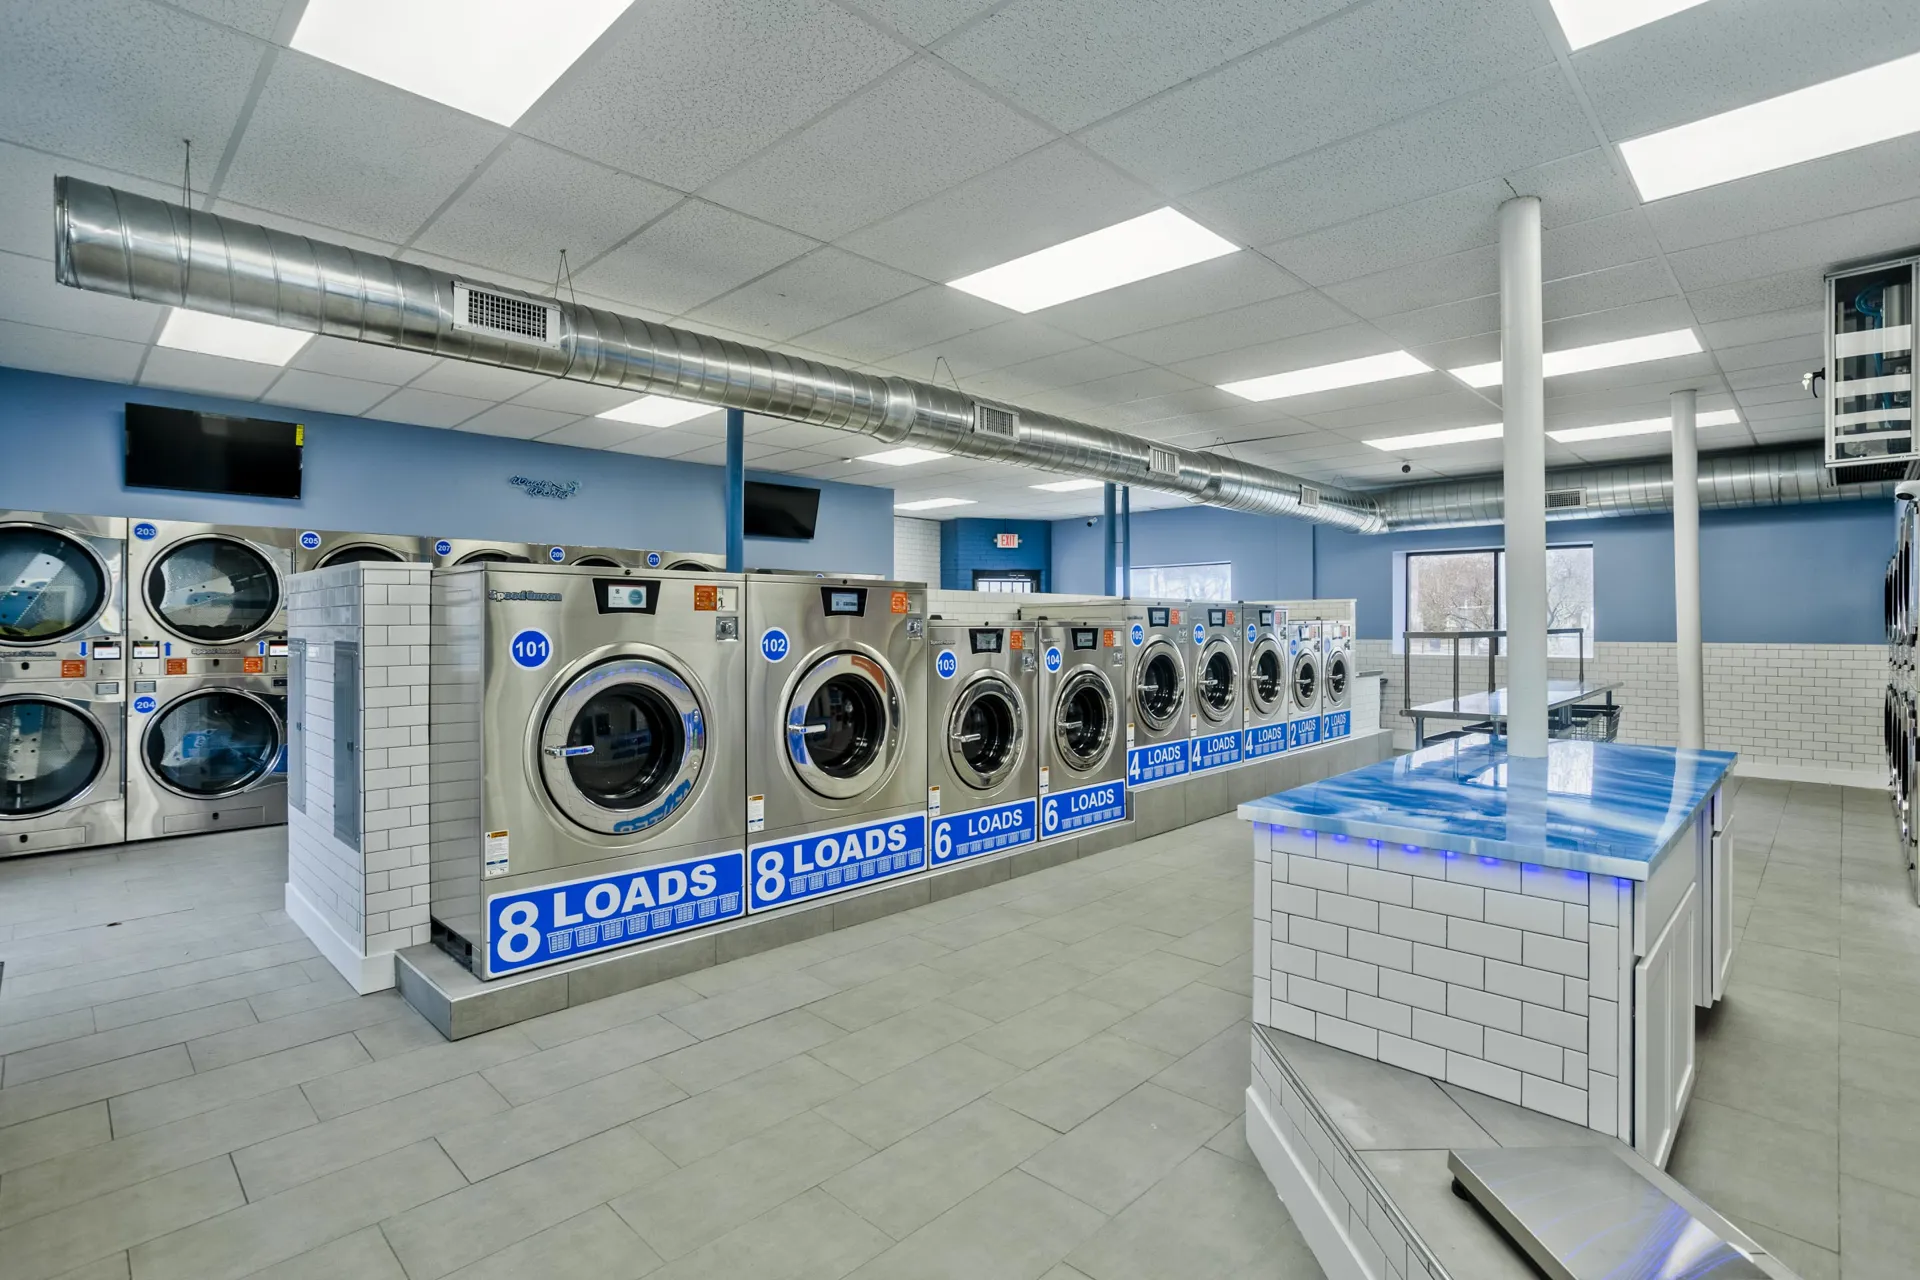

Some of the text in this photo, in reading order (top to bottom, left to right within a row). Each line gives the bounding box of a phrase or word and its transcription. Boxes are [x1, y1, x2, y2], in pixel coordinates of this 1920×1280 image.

[136, 527, 156, 538] 203
[1001, 535, 1015, 546] EXIT
[302, 536, 319, 546] 205
[437, 544, 451, 552] 207
[489, 590, 562, 602] Speed Queen
[1132, 630, 1143, 640] 105
[515, 641, 547, 658] 101
[762, 638, 786, 653] 102
[938, 661, 955, 671] 103
[1046, 655, 1060, 665] 104
[136, 700, 156, 711] 204
[1290, 718, 1316, 745] 2 LOADS
[1324, 713, 1347, 737] 2 LOADS
[1245, 726, 1282, 755] 4 LOADS
[1192, 735, 1236, 767] 4 LOADS
[1128, 745, 1181, 781] 4 LOADS
[1044, 788, 1115, 832] 6 LOADS
[934, 808, 1023, 859] 6 LOADS
[755, 824, 907, 902] 8 LOADS
[497, 864, 717, 963] 8 LOADS
